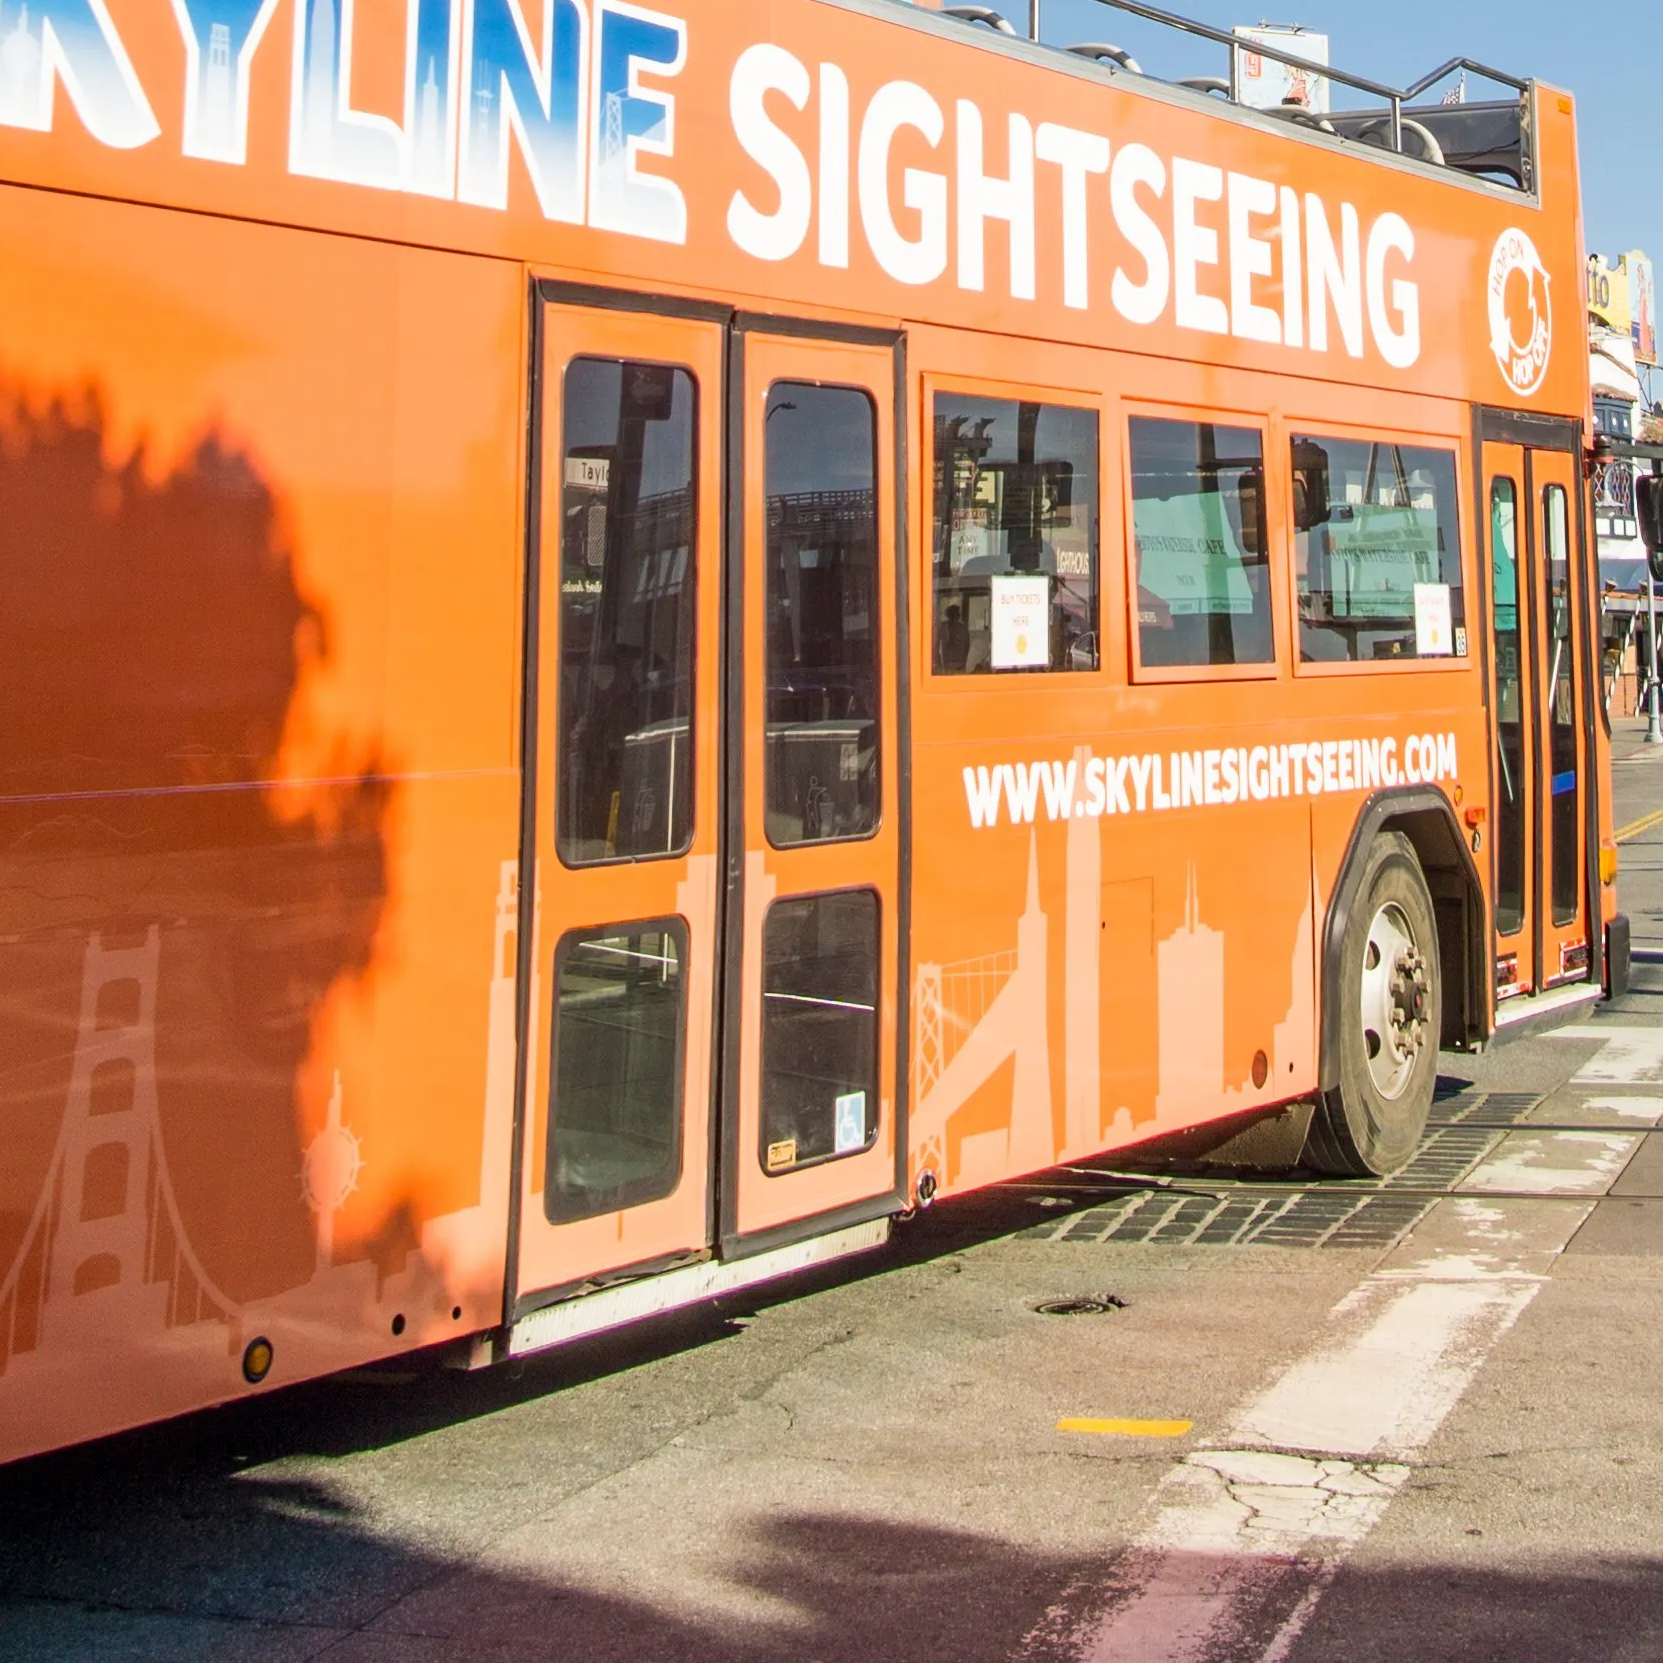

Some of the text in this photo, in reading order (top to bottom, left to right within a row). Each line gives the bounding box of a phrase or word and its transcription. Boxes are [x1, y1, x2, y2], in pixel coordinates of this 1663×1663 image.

[727, 43, 1421, 370] SIGHTSEEING
[1492, 237, 1525, 297] HOP ON
[1512, 316, 1548, 385] HOP OFF
[963, 732, 1458, 828] WWW.SKYLINESIGHTSEEING.COM
